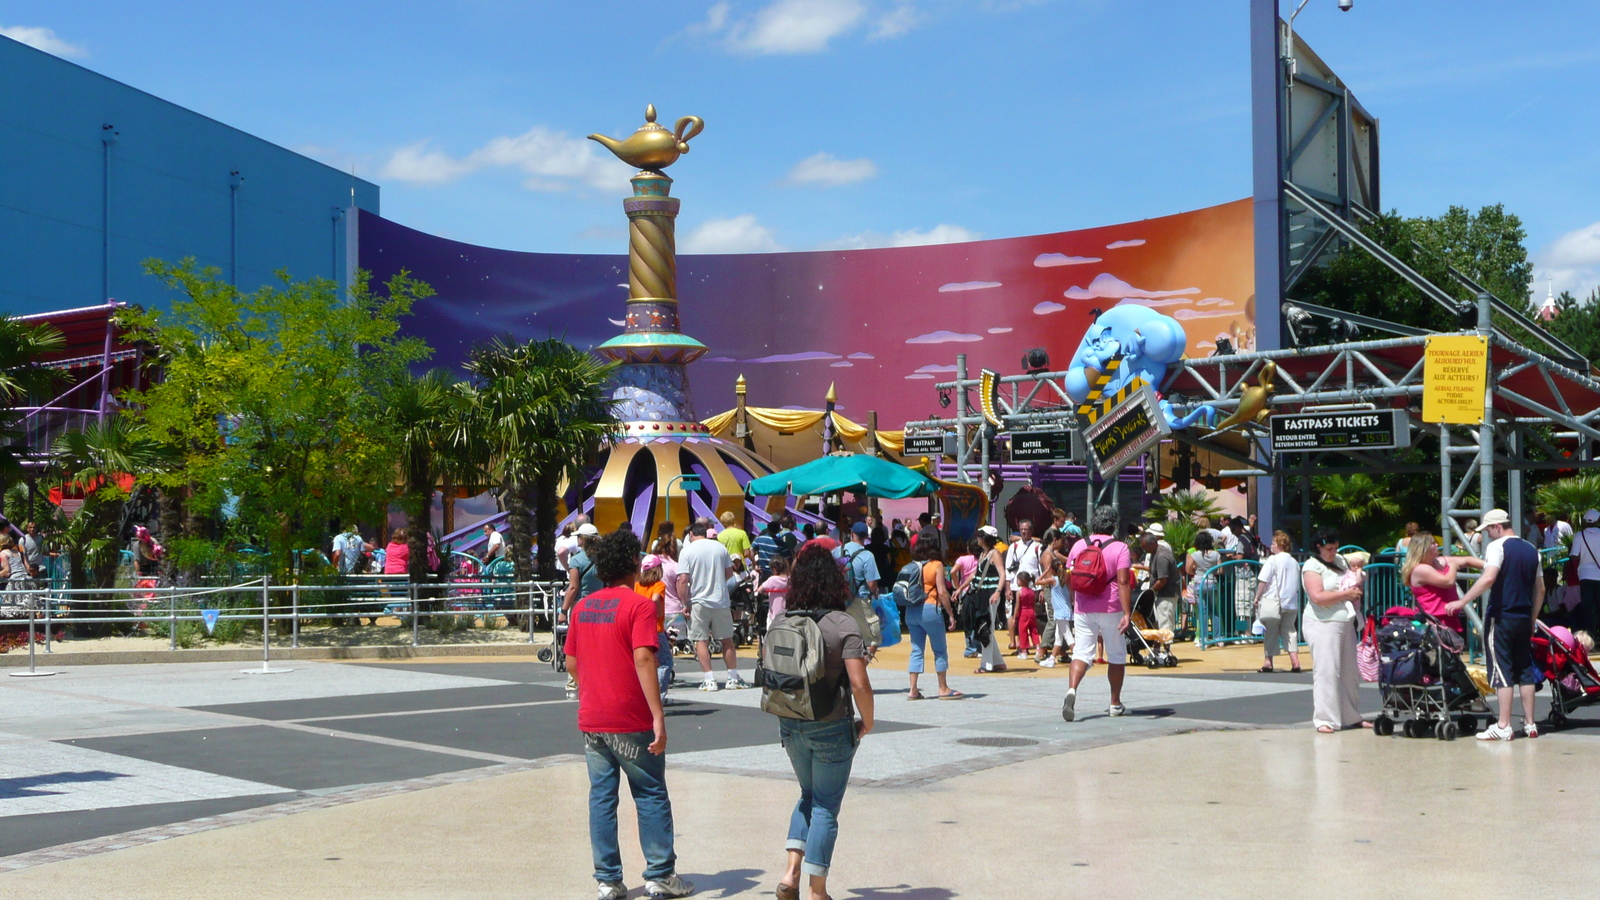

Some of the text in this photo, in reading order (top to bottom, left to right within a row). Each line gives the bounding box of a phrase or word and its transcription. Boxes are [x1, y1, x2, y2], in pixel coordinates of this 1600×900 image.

[1284, 416, 1379, 430] FASTPASS TICKETS
[613, 734, 639, 759] devil
